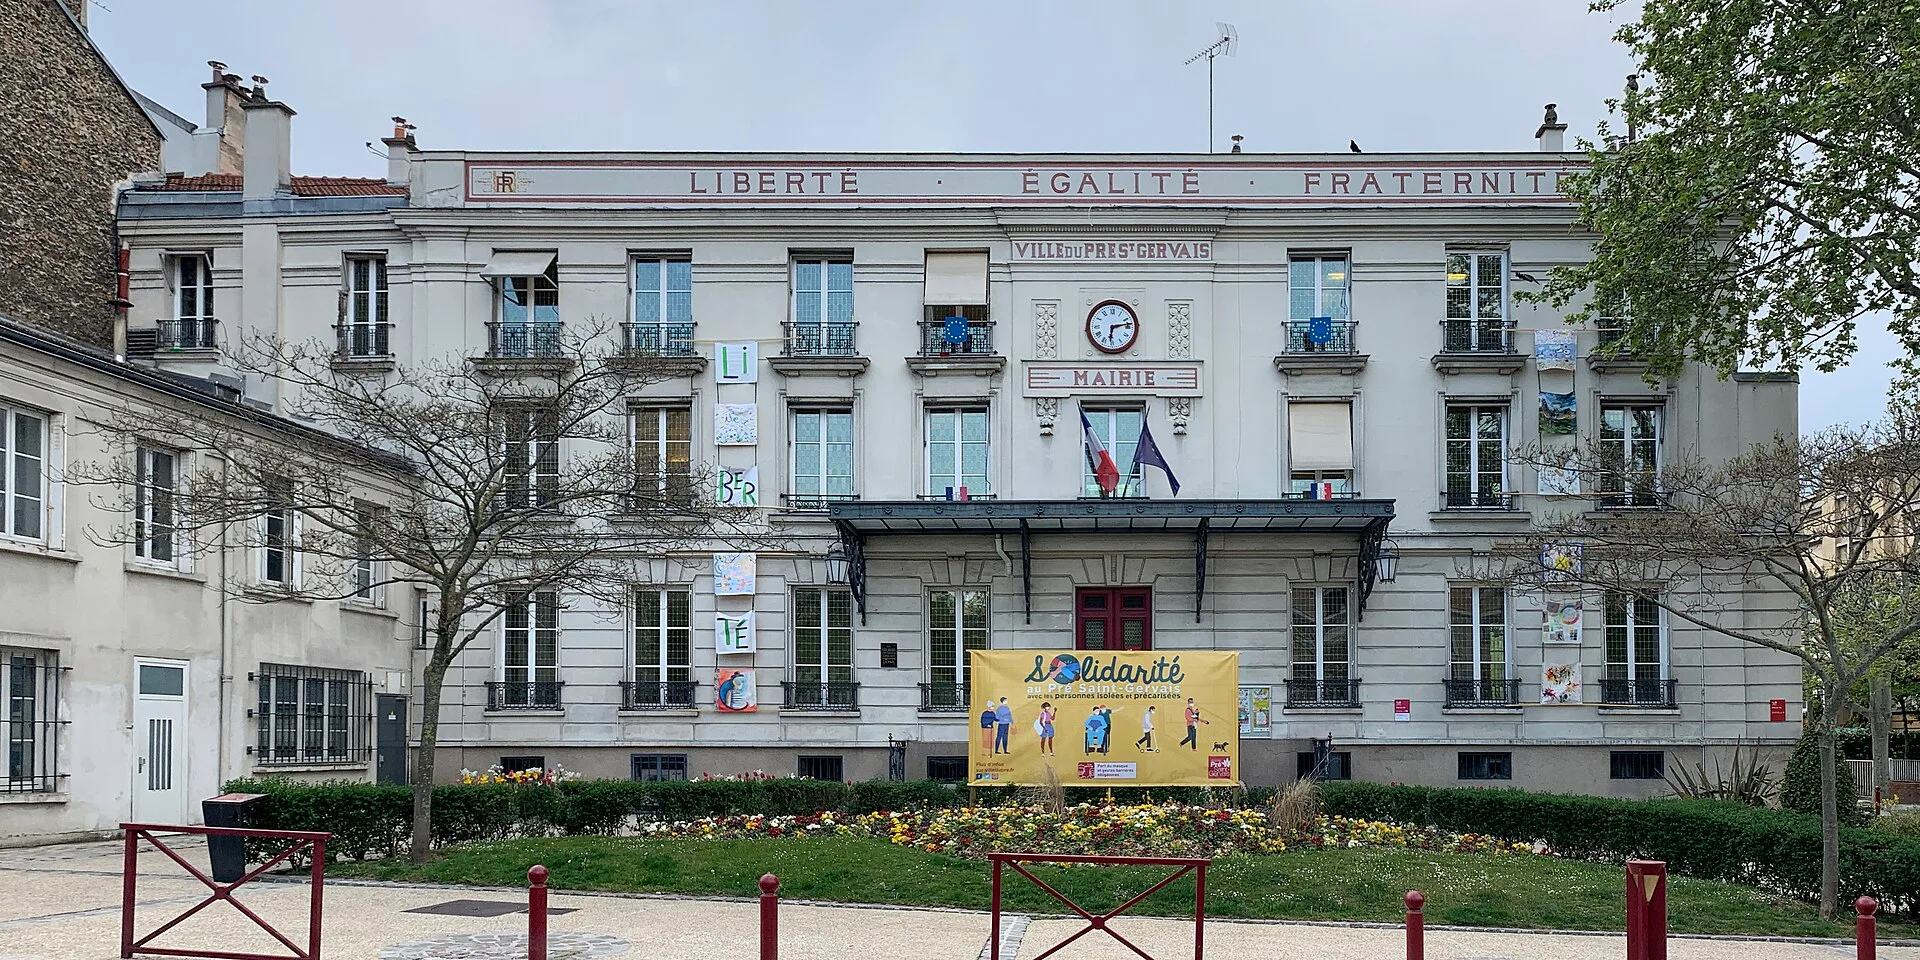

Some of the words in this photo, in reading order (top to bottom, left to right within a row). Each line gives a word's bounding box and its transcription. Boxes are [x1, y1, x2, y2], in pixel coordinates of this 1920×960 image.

[689, 168, 859, 194] LIBERTÉ
[1022, 168, 1200, 194] ÉGALITÉ
[1014, 242, 1064, 259] VILLE
[1064, 246, 1083, 259] DU
[1136, 242, 1210, 259] GERVAIS
[1073, 370, 1155, 386] MAIRIE
[717, 470, 758, 505] BER
[716, 618, 749, 649] TÉ
[1048, 683, 1072, 693] Pré
[1079, 683, 1181, 693] Saint-Gervais
[1133, 692, 1181, 700] précarisées
